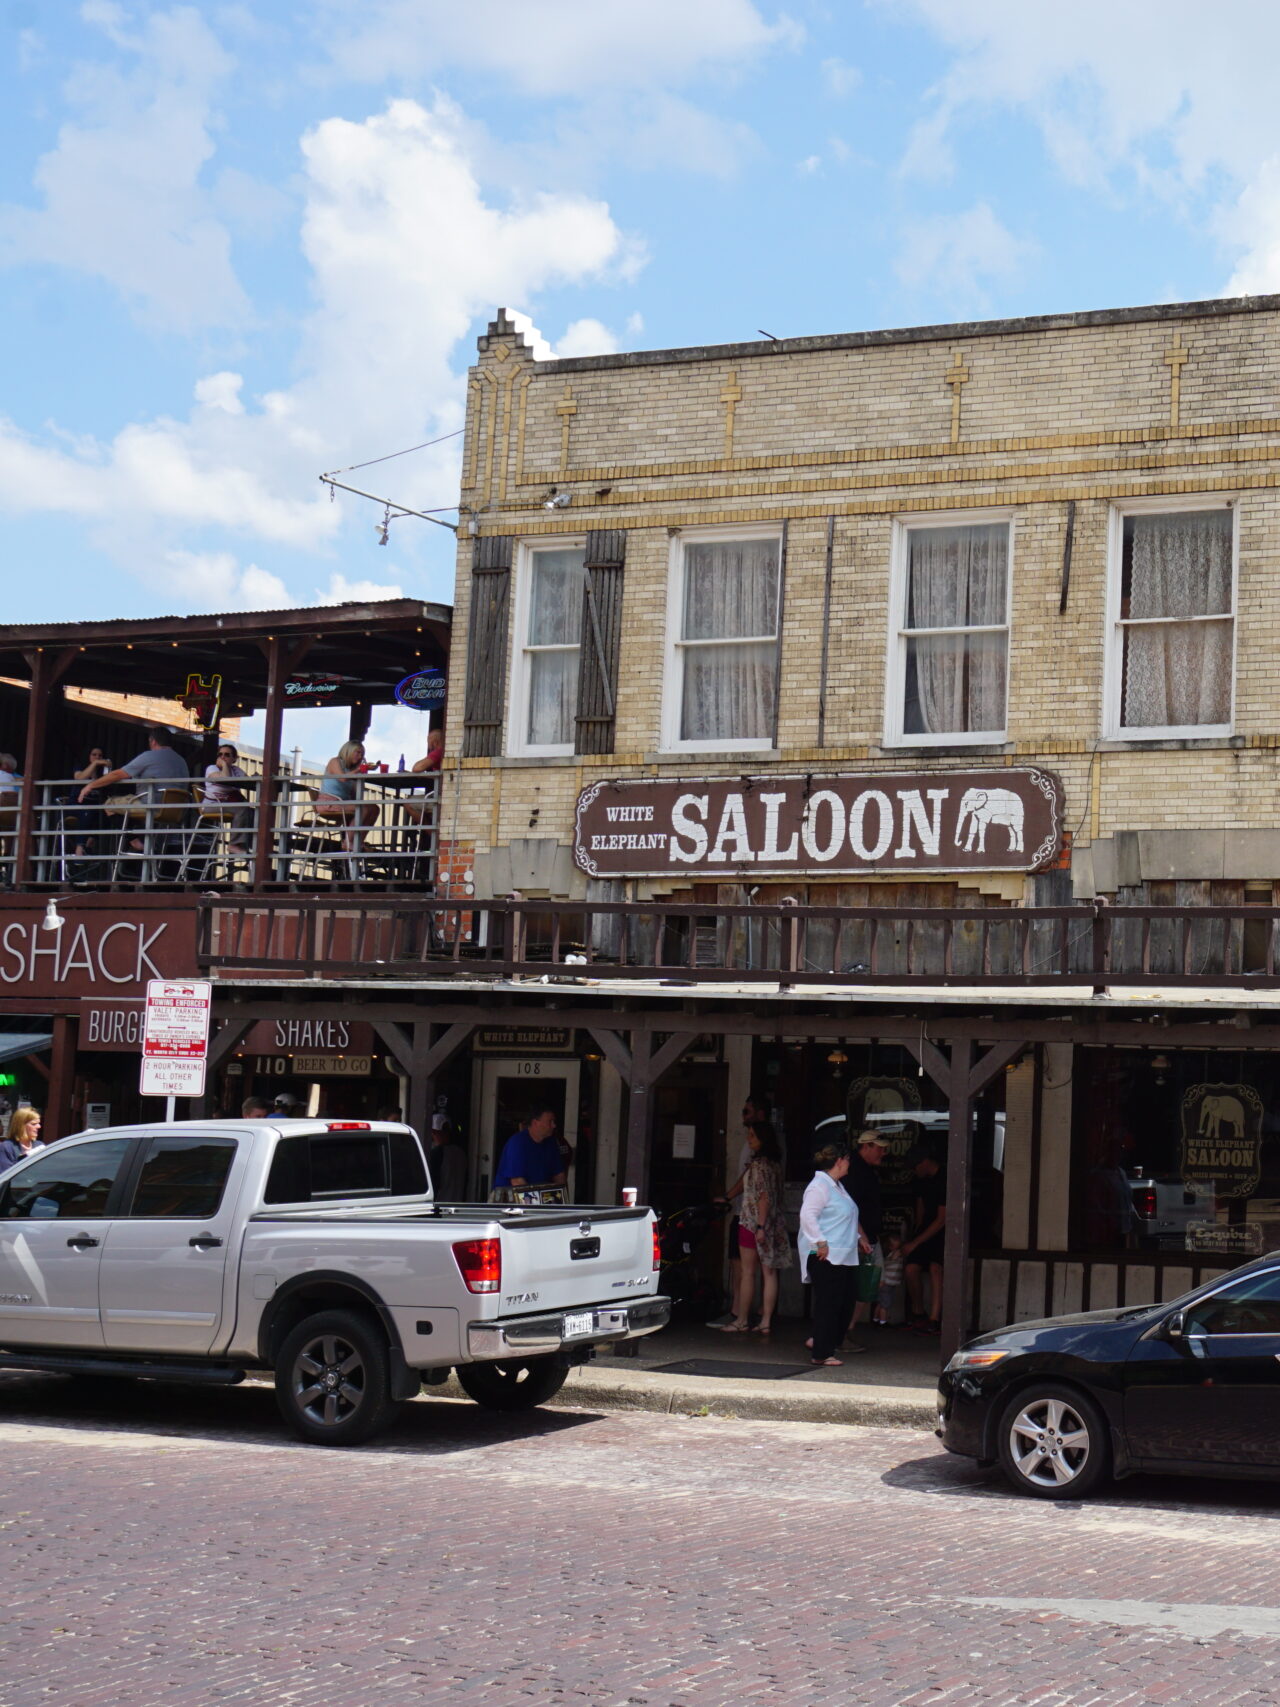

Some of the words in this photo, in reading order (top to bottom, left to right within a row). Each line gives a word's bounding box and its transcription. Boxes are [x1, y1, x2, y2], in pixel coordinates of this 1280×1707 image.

[284, 681, 341, 696] Budweiser
[412, 677, 446, 688] BUD
[403, 688, 446, 699] LIGHT
[605, 805, 654, 823] WHITE
[669, 787, 949, 864] SALOON
[590, 833, 668, 851] ELEPHANT
[0, 922, 168, 983] SHACK
[151, 998, 174, 1006] TOWING
[175, 999, 206, 1008] ENFORCED
[275, 1019, 350, 1048] SHAKES
[483, 1032, 514, 1043] WHITE
[517, 1032, 565, 1043] ELEPHANT
[145, 1062, 150, 1070] 2
[153, 1062, 171, 1070] HOUR
[174, 1063, 202, 1071] PARKING
[256, 1057, 286, 1075] 110
[296, 1059, 327, 1071] BEER
[330, 1059, 348, 1072] TO
[351, 1059, 368, 1072] GO
[517, 1062, 541, 1075] 108
[154, 1072, 166, 1080] ALL
[169, 1073, 192, 1081] OTHER
[162, 1082, 183, 1090] TIMES
[1187, 1138, 1214, 1147] WHITE
[1216, 1139, 1255, 1149] ELEPHANT
[1187, 1148, 1255, 1167] SALOON
[1195, 1227, 1253, 1241] Esquire
[505, 1291, 540, 1306] TITAN
